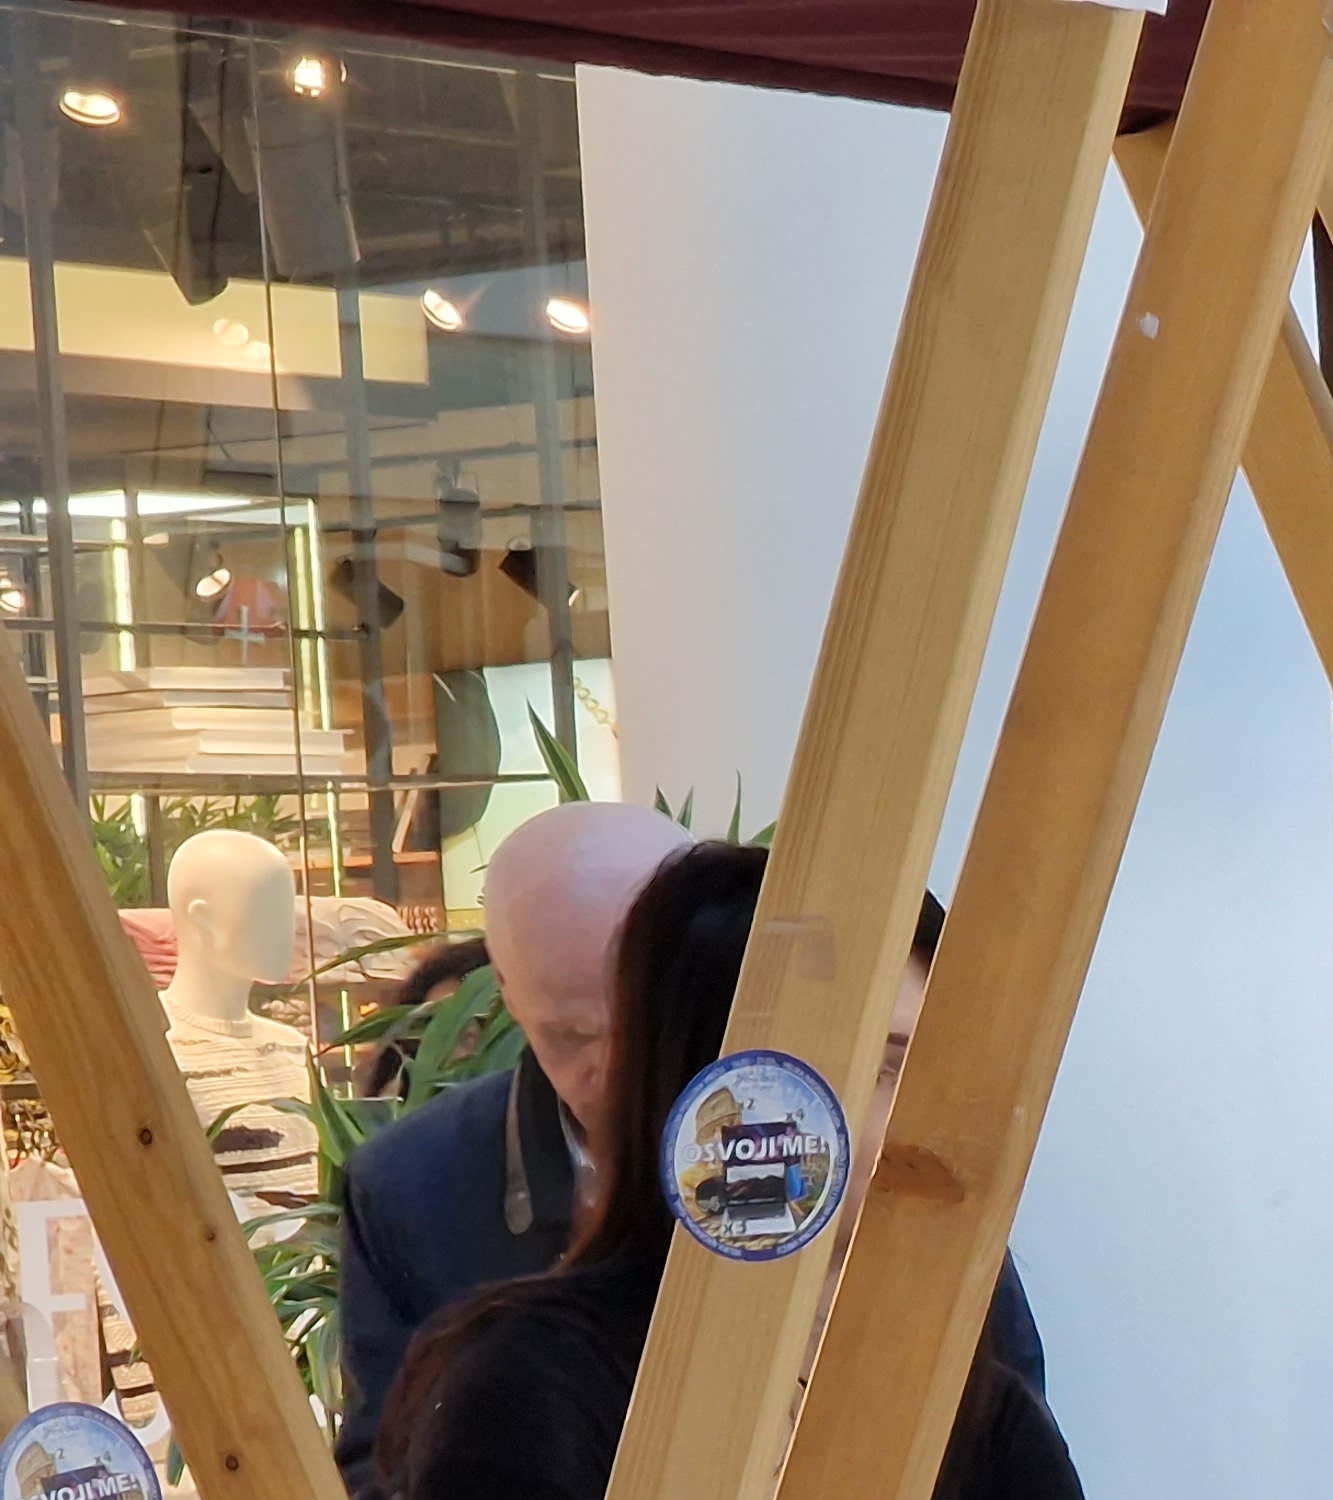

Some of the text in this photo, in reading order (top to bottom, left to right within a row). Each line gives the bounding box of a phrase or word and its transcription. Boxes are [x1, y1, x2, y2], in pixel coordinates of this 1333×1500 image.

[683, 1134, 828, 1164] OSVOJI ME!
[99, 1472, 138, 1499] ME!
